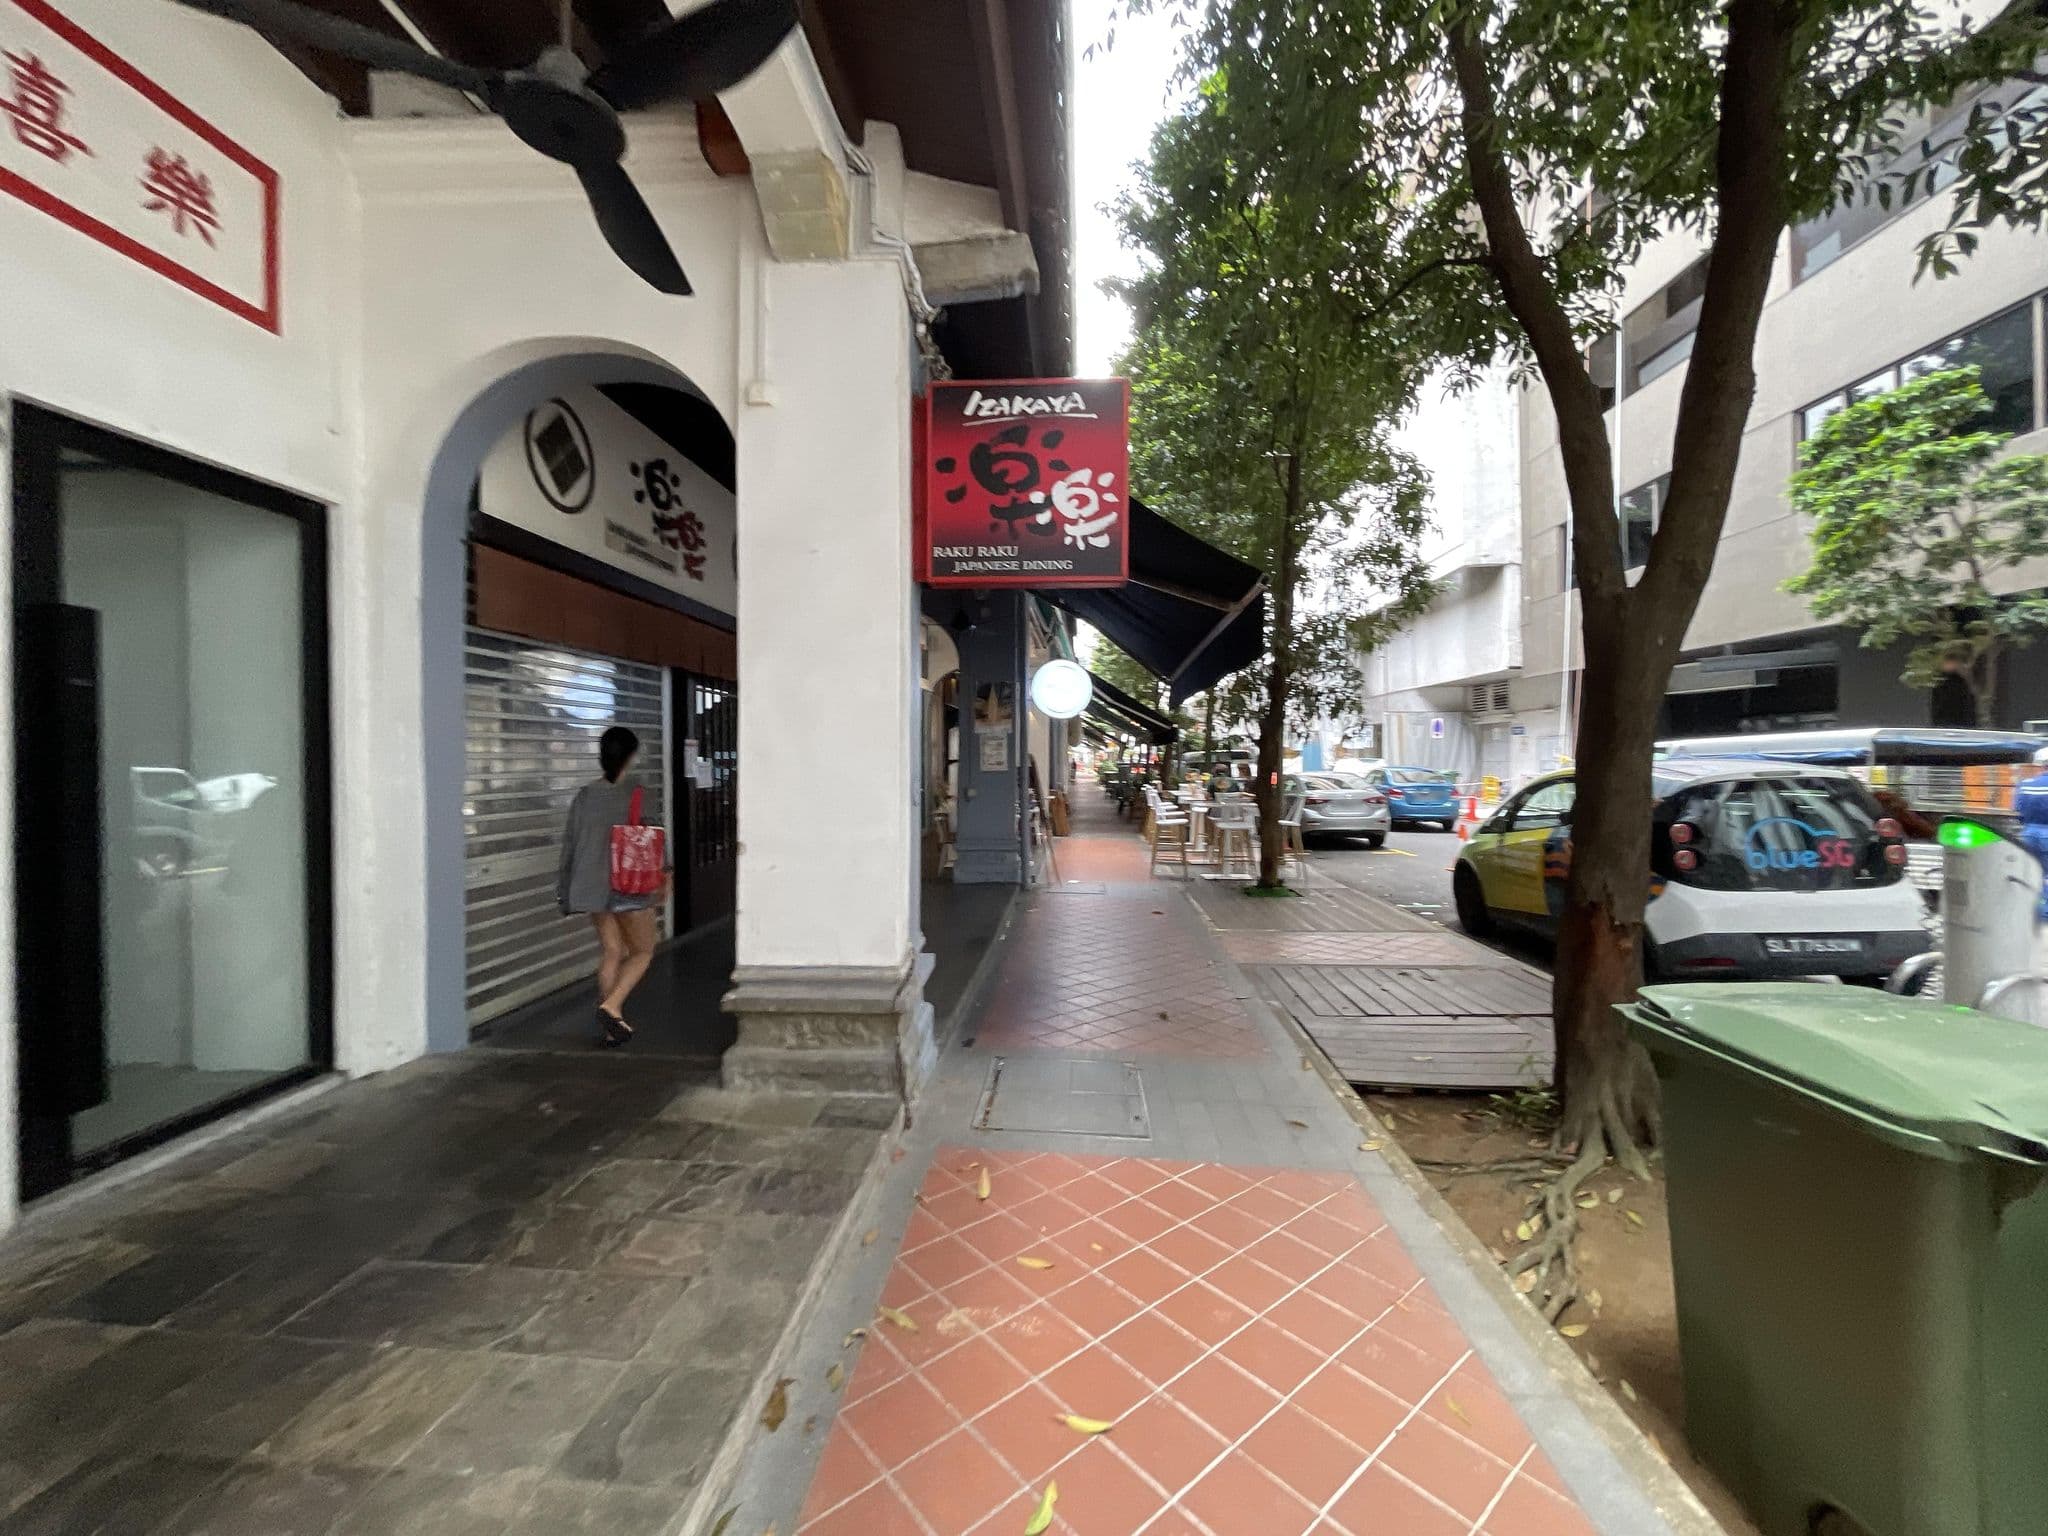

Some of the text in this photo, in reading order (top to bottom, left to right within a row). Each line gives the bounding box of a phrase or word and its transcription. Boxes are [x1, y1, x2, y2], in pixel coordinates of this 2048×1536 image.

[962, 390, 1086, 417] IZAKAYA
[932, 545, 1019, 558] RAKU RAKU
[953, 560, 1073, 573] JAPANESE DINING
[1744, 828, 1856, 870] blueSG
